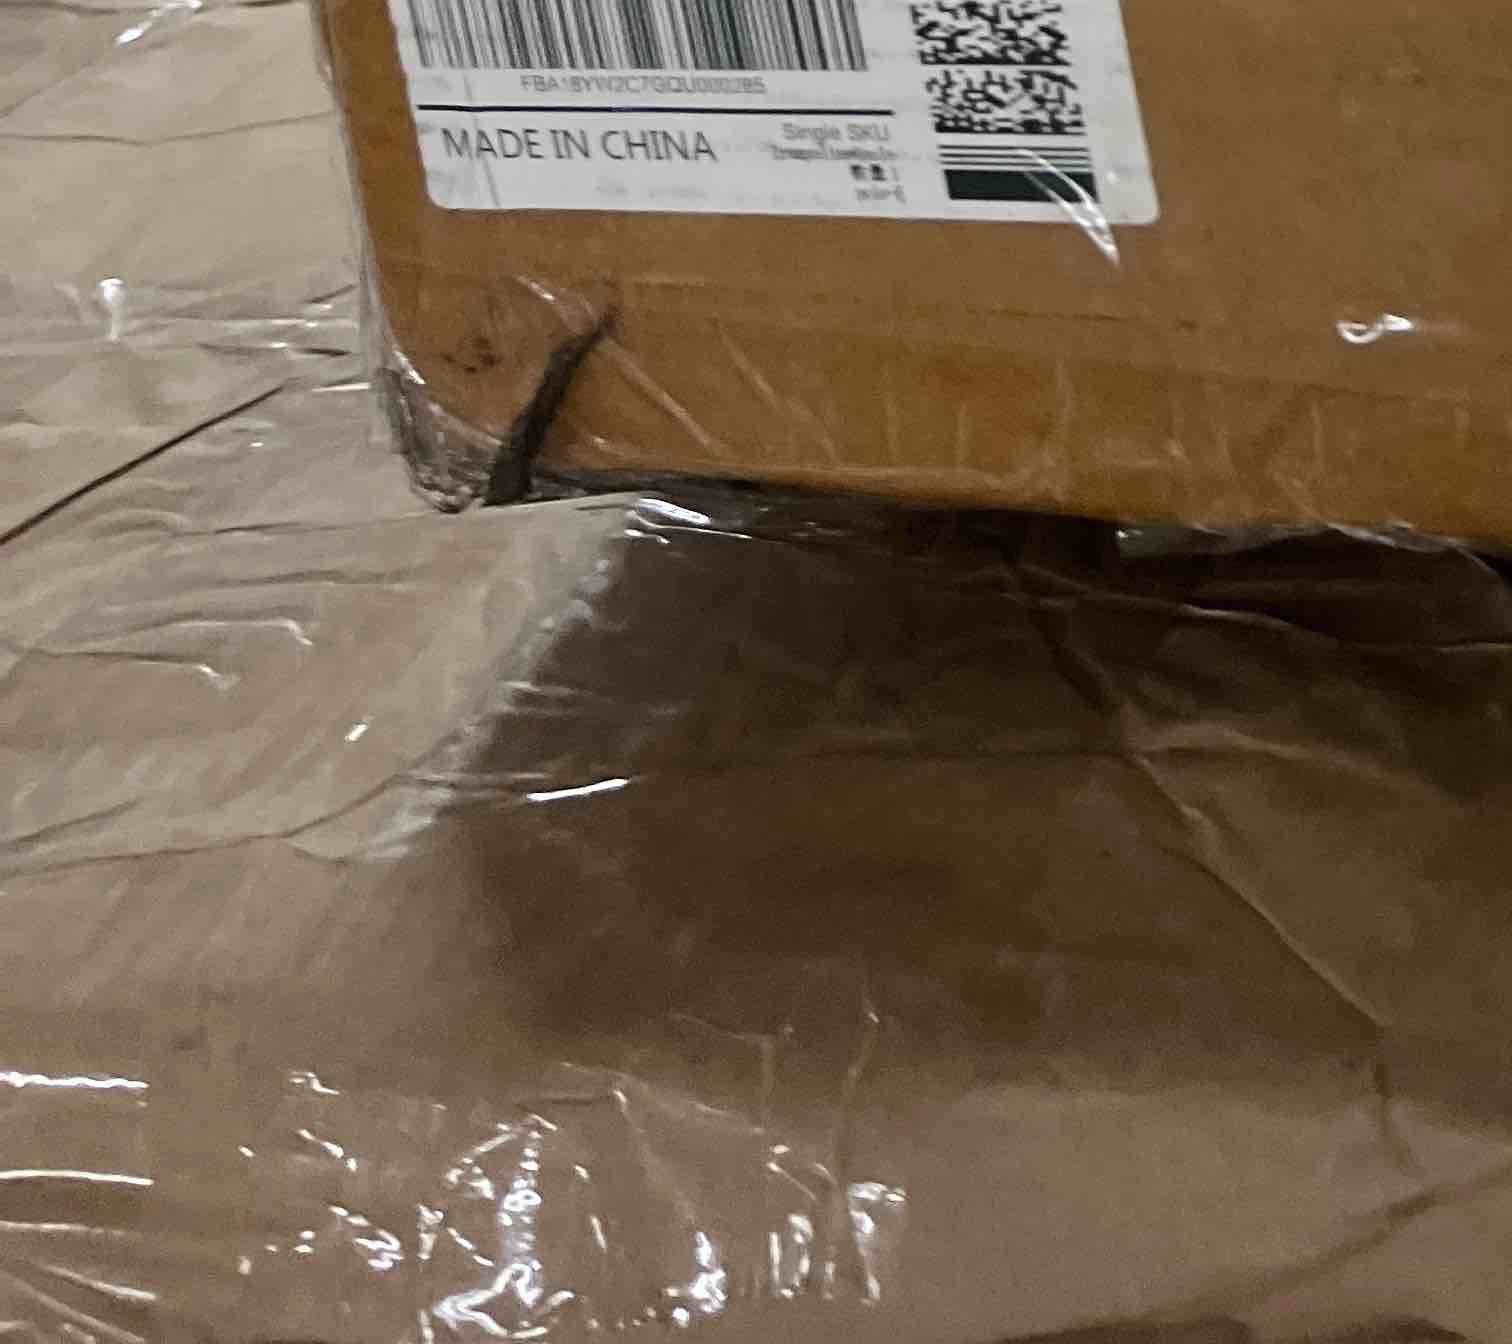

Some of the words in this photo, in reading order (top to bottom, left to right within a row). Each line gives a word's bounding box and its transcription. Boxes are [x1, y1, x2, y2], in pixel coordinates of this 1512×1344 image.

[440, 128, 545, 160] MADE
[553, 128, 591, 161] IN
[600, 129, 718, 163] CHINA
[781, 122, 842, 147] Single
[847, 122, 890, 142] SKU
